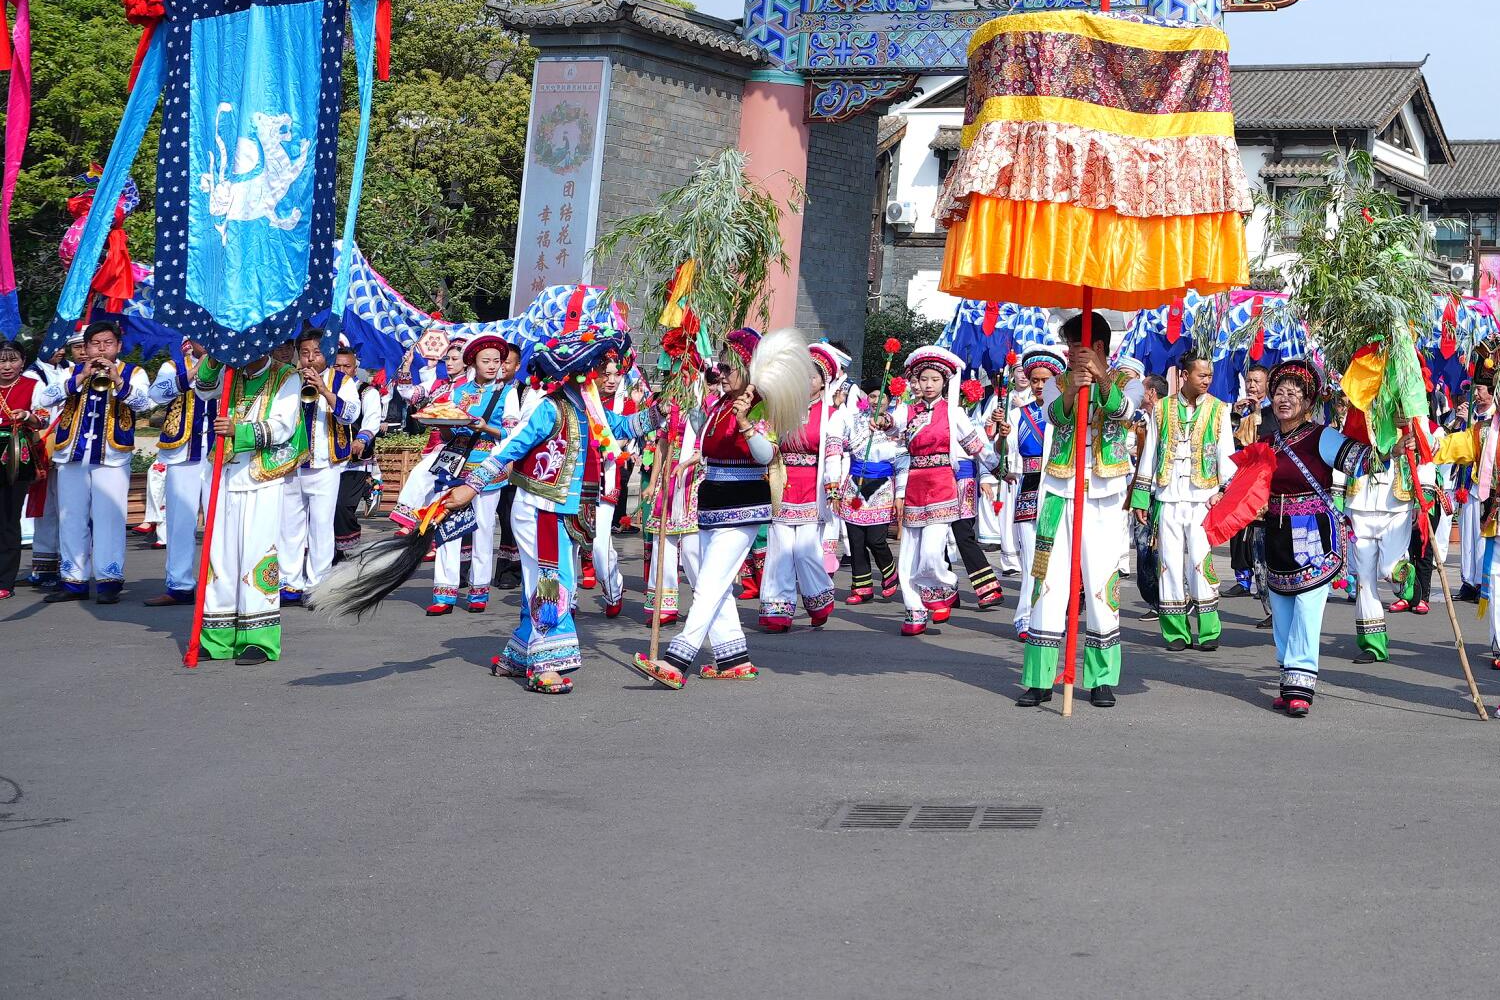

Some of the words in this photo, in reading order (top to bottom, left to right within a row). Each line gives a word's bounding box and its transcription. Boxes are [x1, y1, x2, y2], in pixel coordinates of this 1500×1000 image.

[531, 205, 552, 292] 幸福春城
[556, 180, 575, 268] 团结花开
